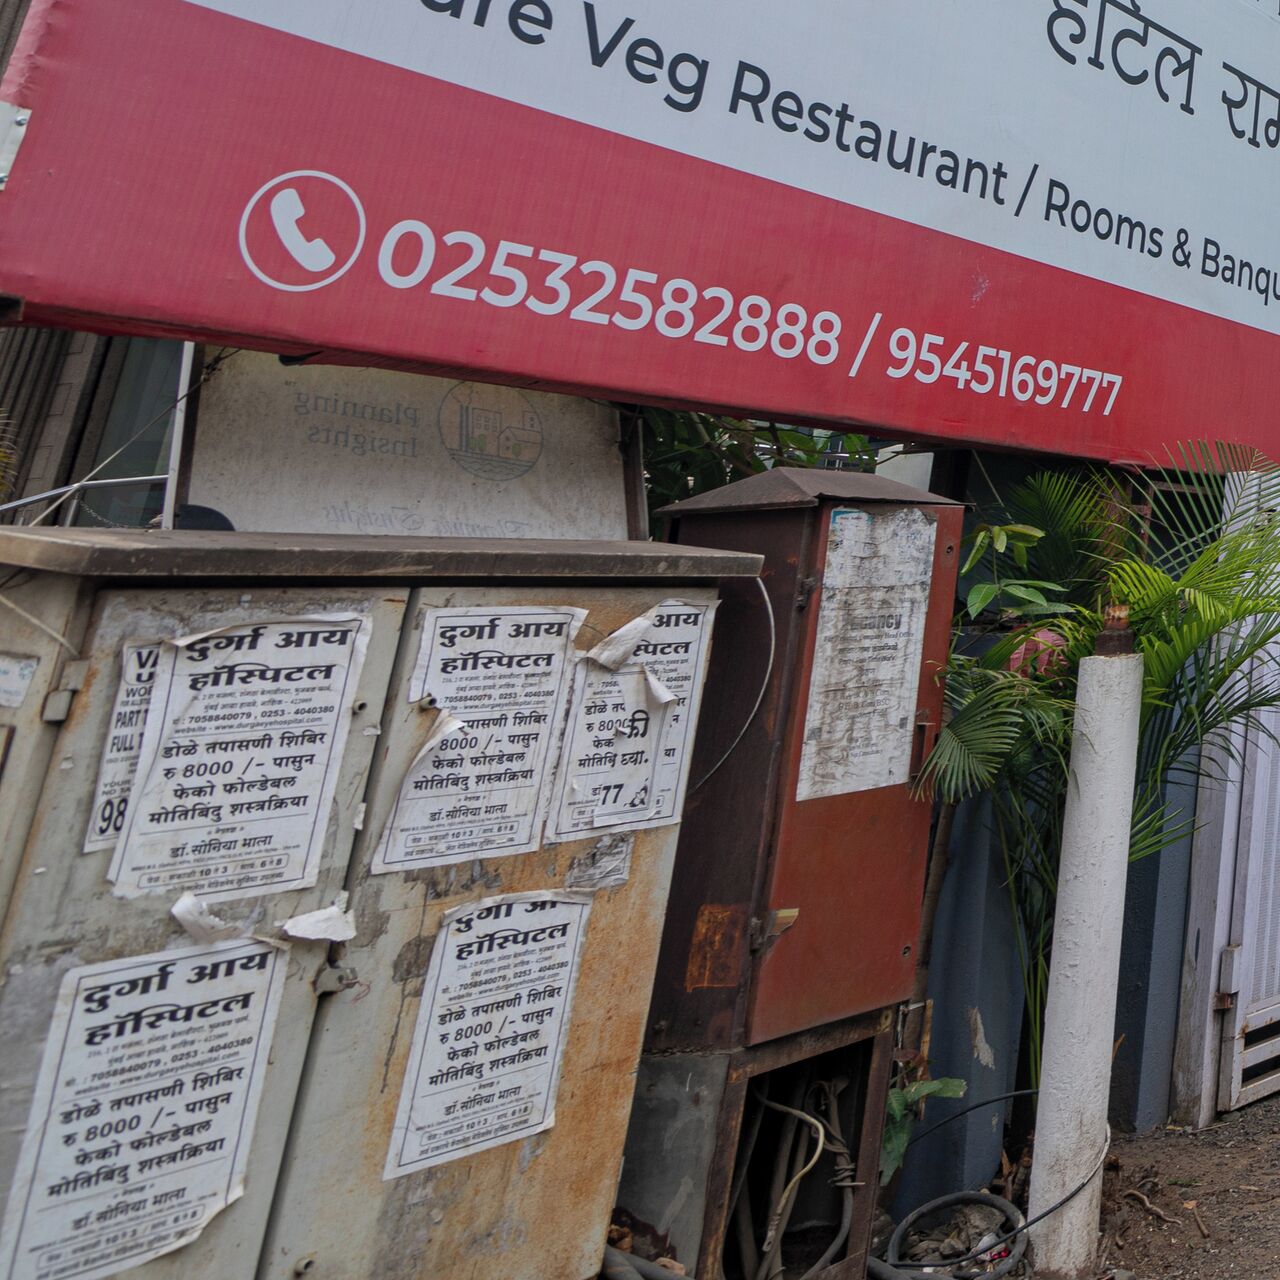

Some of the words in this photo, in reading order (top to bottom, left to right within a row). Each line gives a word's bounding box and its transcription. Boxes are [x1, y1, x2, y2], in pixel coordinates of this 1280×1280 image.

[582, 1, 710, 113] Veg
[729, 61, 1008, 207] Restaurant
[1044, 178, 1163, 259] Rooms
[1172, 228, 1192, 269] &
[378, 219, 842, 366] 02532582888
[886, 327, 1123, 417] 9545169777
[439, 617, 502, 648] दुर्गा
[508, 622, 569, 638] आय
[652, 611, 702, 629] आय
[186, 626, 268, 662] दुर्गा
[275, 629, 353, 648] आय
[440, 649, 556, 674] हॉस्पिटल
[188, 662, 337, 691] हॉस्पिटल
[114, 710, 142, 729] PART
[261, 710, 285, 718] 0253
[293, 705, 335, 716] 4040380
[512, 710, 548, 726] शिबिर
[584, 700, 607, 715] डोळे
[110, 736, 134, 753] FULL
[161, 739, 199, 759] डोळे
[205, 733, 273, 754] तपासणी
[280, 731, 327, 748] शिबिर
[439, 736, 479, 752] 8000
[508, 732, 540, 748] पासुन
[182, 760, 233, 778] 8000
[272, 754, 316, 772] पासुन
[432, 754, 465, 770] फेको
[470, 750, 526, 767] फोल्डेबल
[173, 780, 216, 800] फेको
[223, 774, 297, 794] फोल्डेबल
[413, 772, 471, 791] मोतिबिंदु
[600, 783, 625, 806] 77
[148, 801, 223, 823] मोतिबिंदु
[456, 922, 571, 961] हॉस्पिटल
[83, 962, 177, 1014] दुर्गा
[186, 951, 273, 984] आय
[84, 991, 255, 1046] हॉस्पिटल
[438, 1005, 467, 1026] डोळे
[471, 992, 523, 1017] तपासणी
[527, 984, 563, 1005] शिबिर
[454, 1020, 493, 1042] 8000
[521, 1006, 555, 1025] पासुन
[447, 1040, 479, 1062] फेको
[484, 1028, 541, 1054] फोल्डेबल
[428, 1060, 485, 1087] मोतिबिंदु
[60, 1098, 102, 1125] डोळे
[110, 1076, 185, 1111] तपासणी
[192, 1066, 246, 1091] शिबिर
[84, 1114, 141, 1143] 8000
[184, 1091, 234, 1115] पासुन
[74, 1140, 122, 1167] फेको
[130, 1119, 213, 1150] फोल्डेबल
[47, 1163, 130, 1197] मोतिबिंदु
